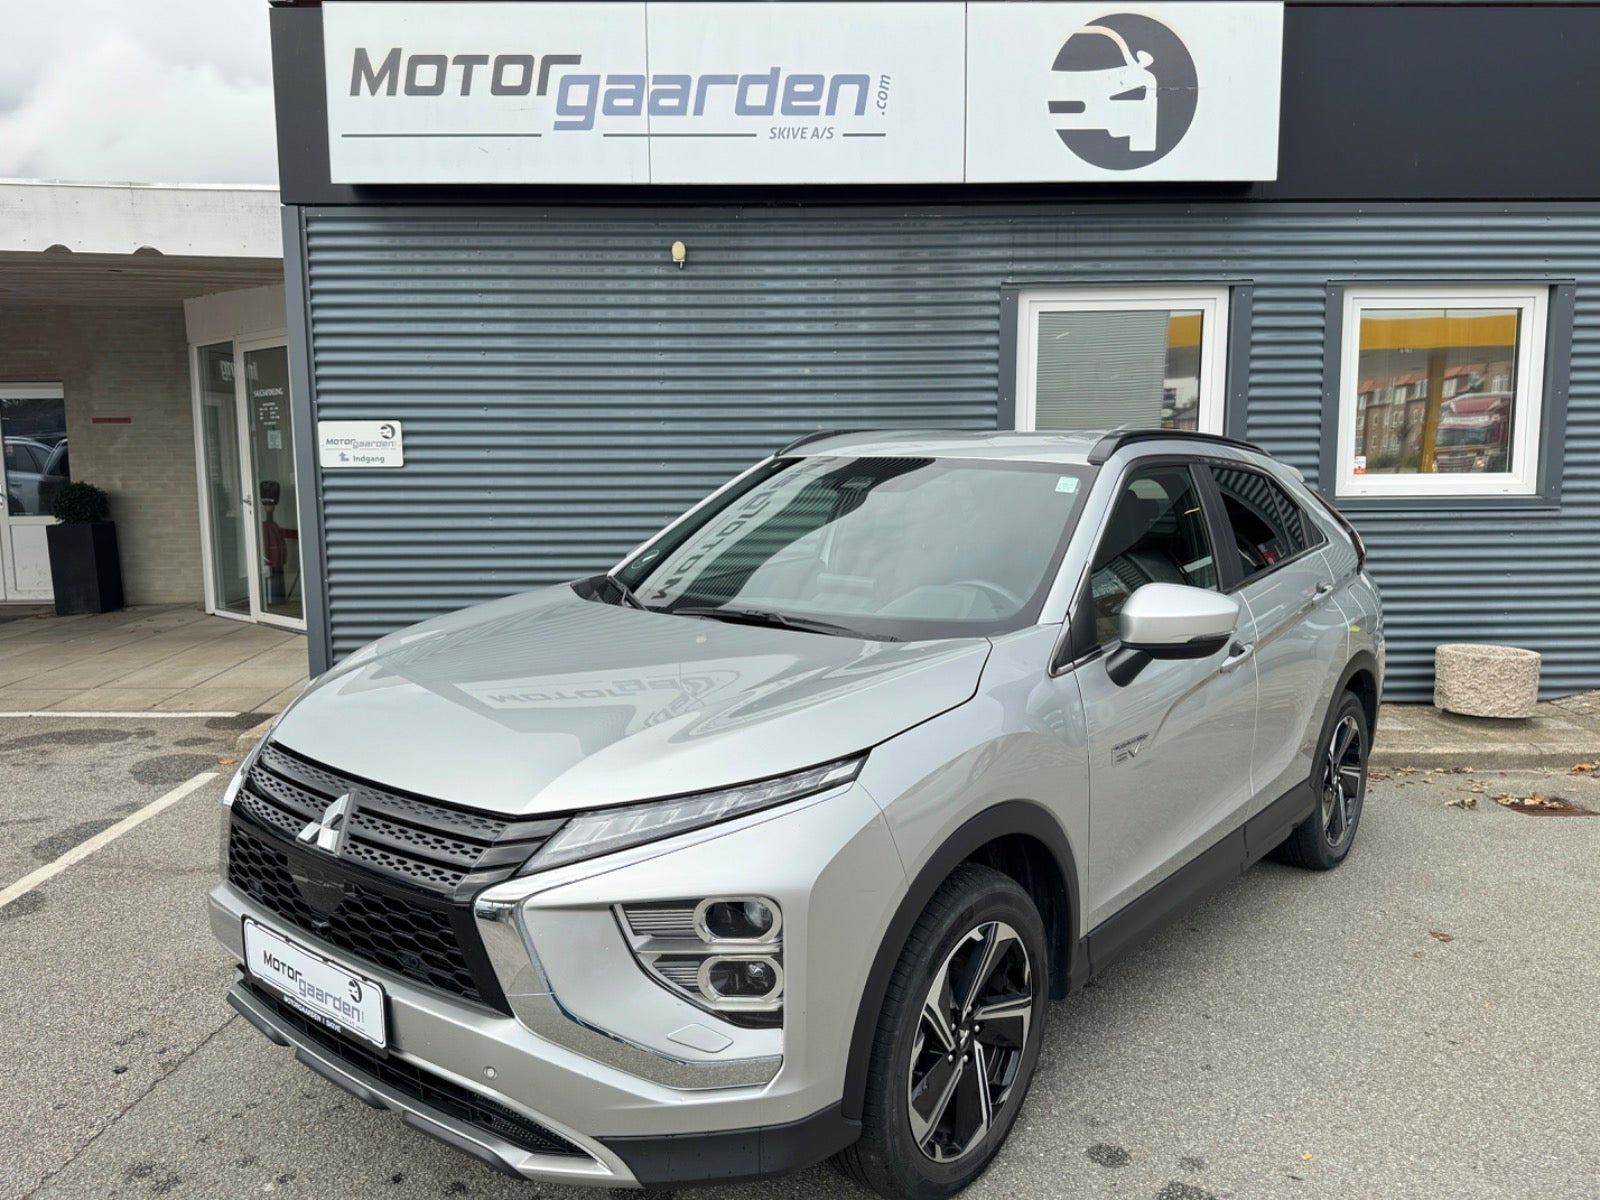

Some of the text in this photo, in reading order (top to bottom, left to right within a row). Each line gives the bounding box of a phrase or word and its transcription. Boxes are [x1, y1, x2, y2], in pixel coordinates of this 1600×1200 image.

[876, 74, 891, 116] .com
[769, 126, 834, 140] SKIVE A/S
[353, 455, 385, 463] Indgang
